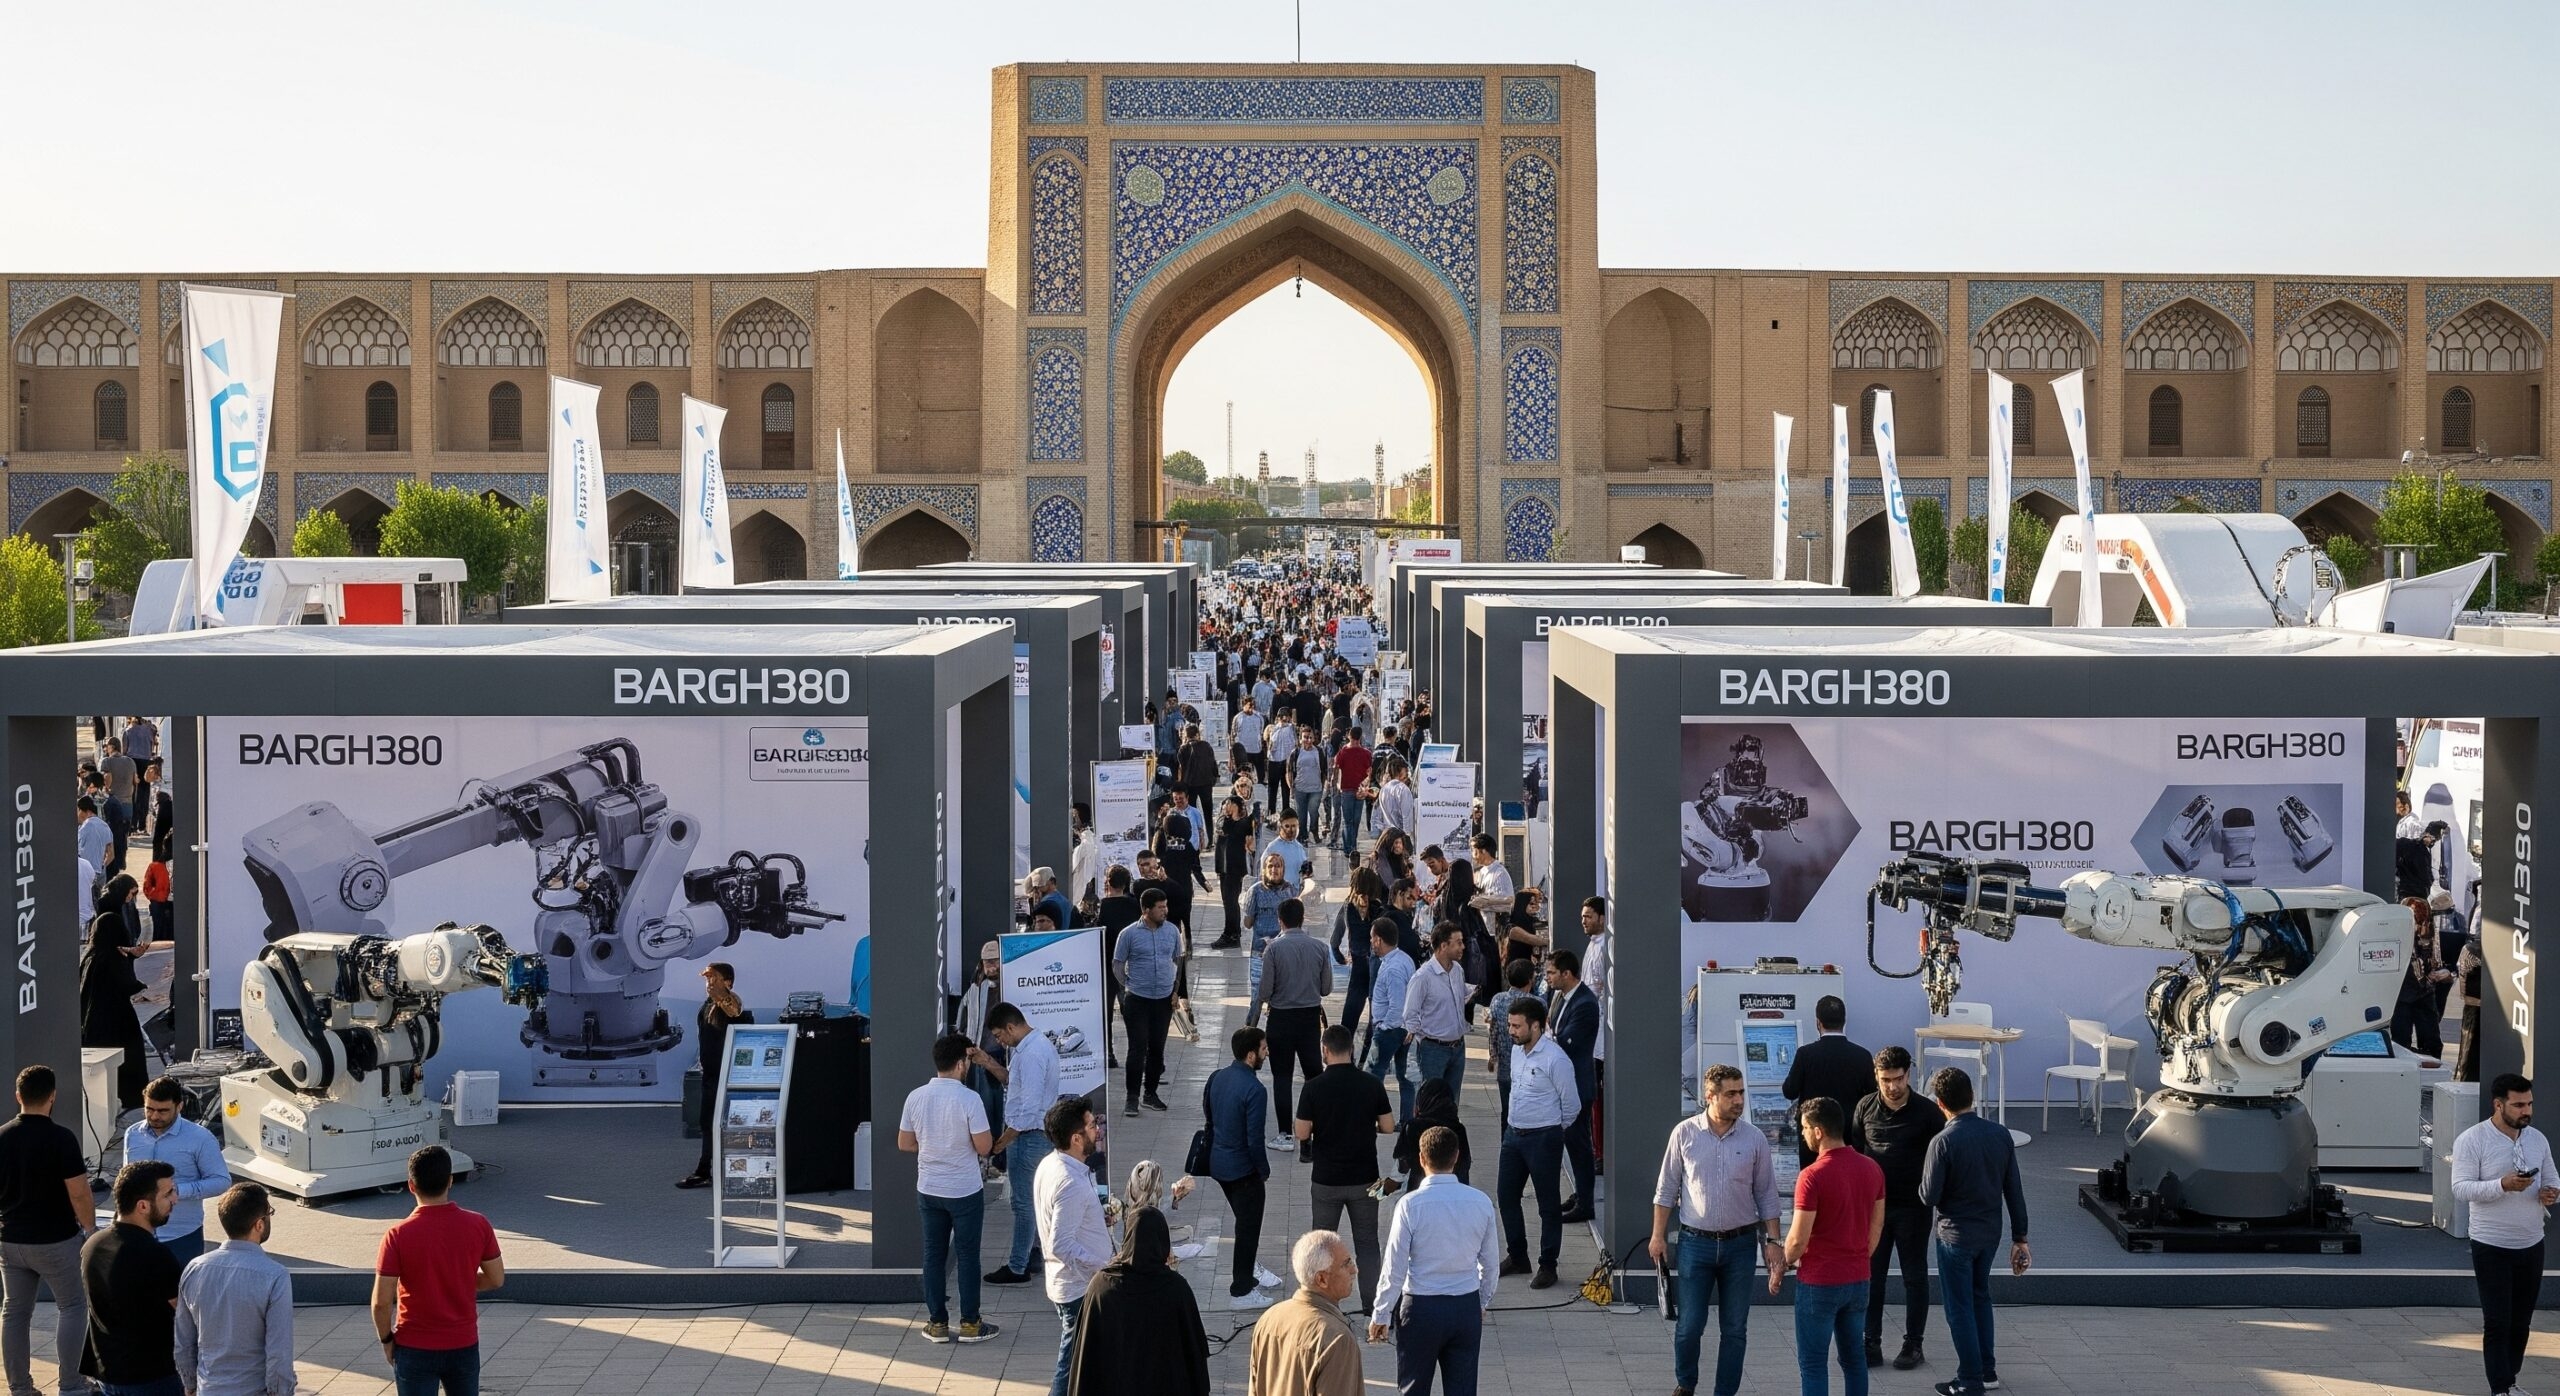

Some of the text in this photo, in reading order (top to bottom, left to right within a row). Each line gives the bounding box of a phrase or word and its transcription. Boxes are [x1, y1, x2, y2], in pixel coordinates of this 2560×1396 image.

[614, 667, 850, 705] BARGH380
[1720, 668, 1950, 706] BARGH380
[239, 733, 442, 766] BARGH380
[2177, 732, 2345, 760] BARGH380
[1889, 820, 2094, 852] BARGH380
[15, 783, 37, 1015] BARH380
